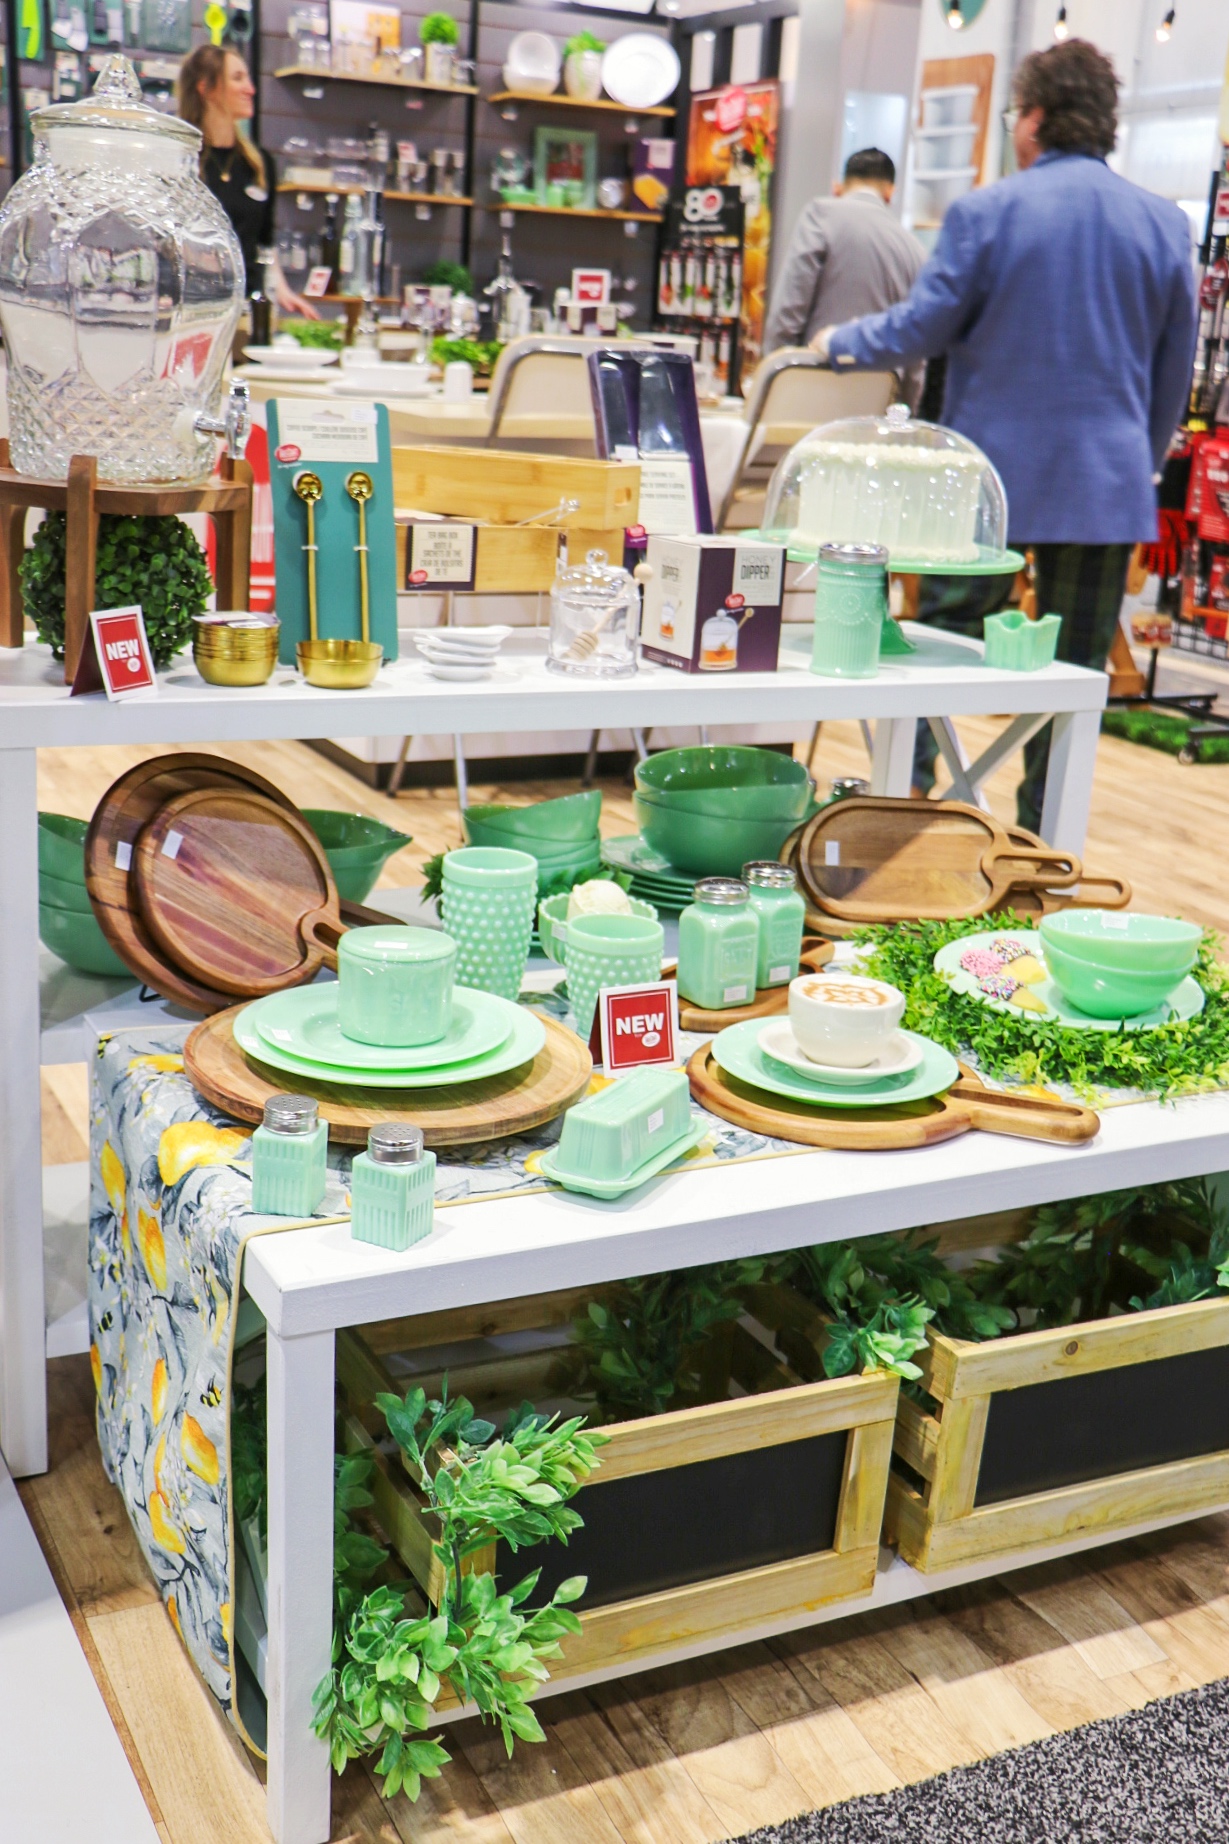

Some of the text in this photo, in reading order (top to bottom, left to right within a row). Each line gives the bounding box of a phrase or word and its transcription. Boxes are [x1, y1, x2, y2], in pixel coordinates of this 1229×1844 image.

[741, 555, 776, 564] HONEY
[741, 564, 770, 580] DIPPER
[105, 639, 140, 661] NEW
[615, 1012, 664, 1036] NEW
